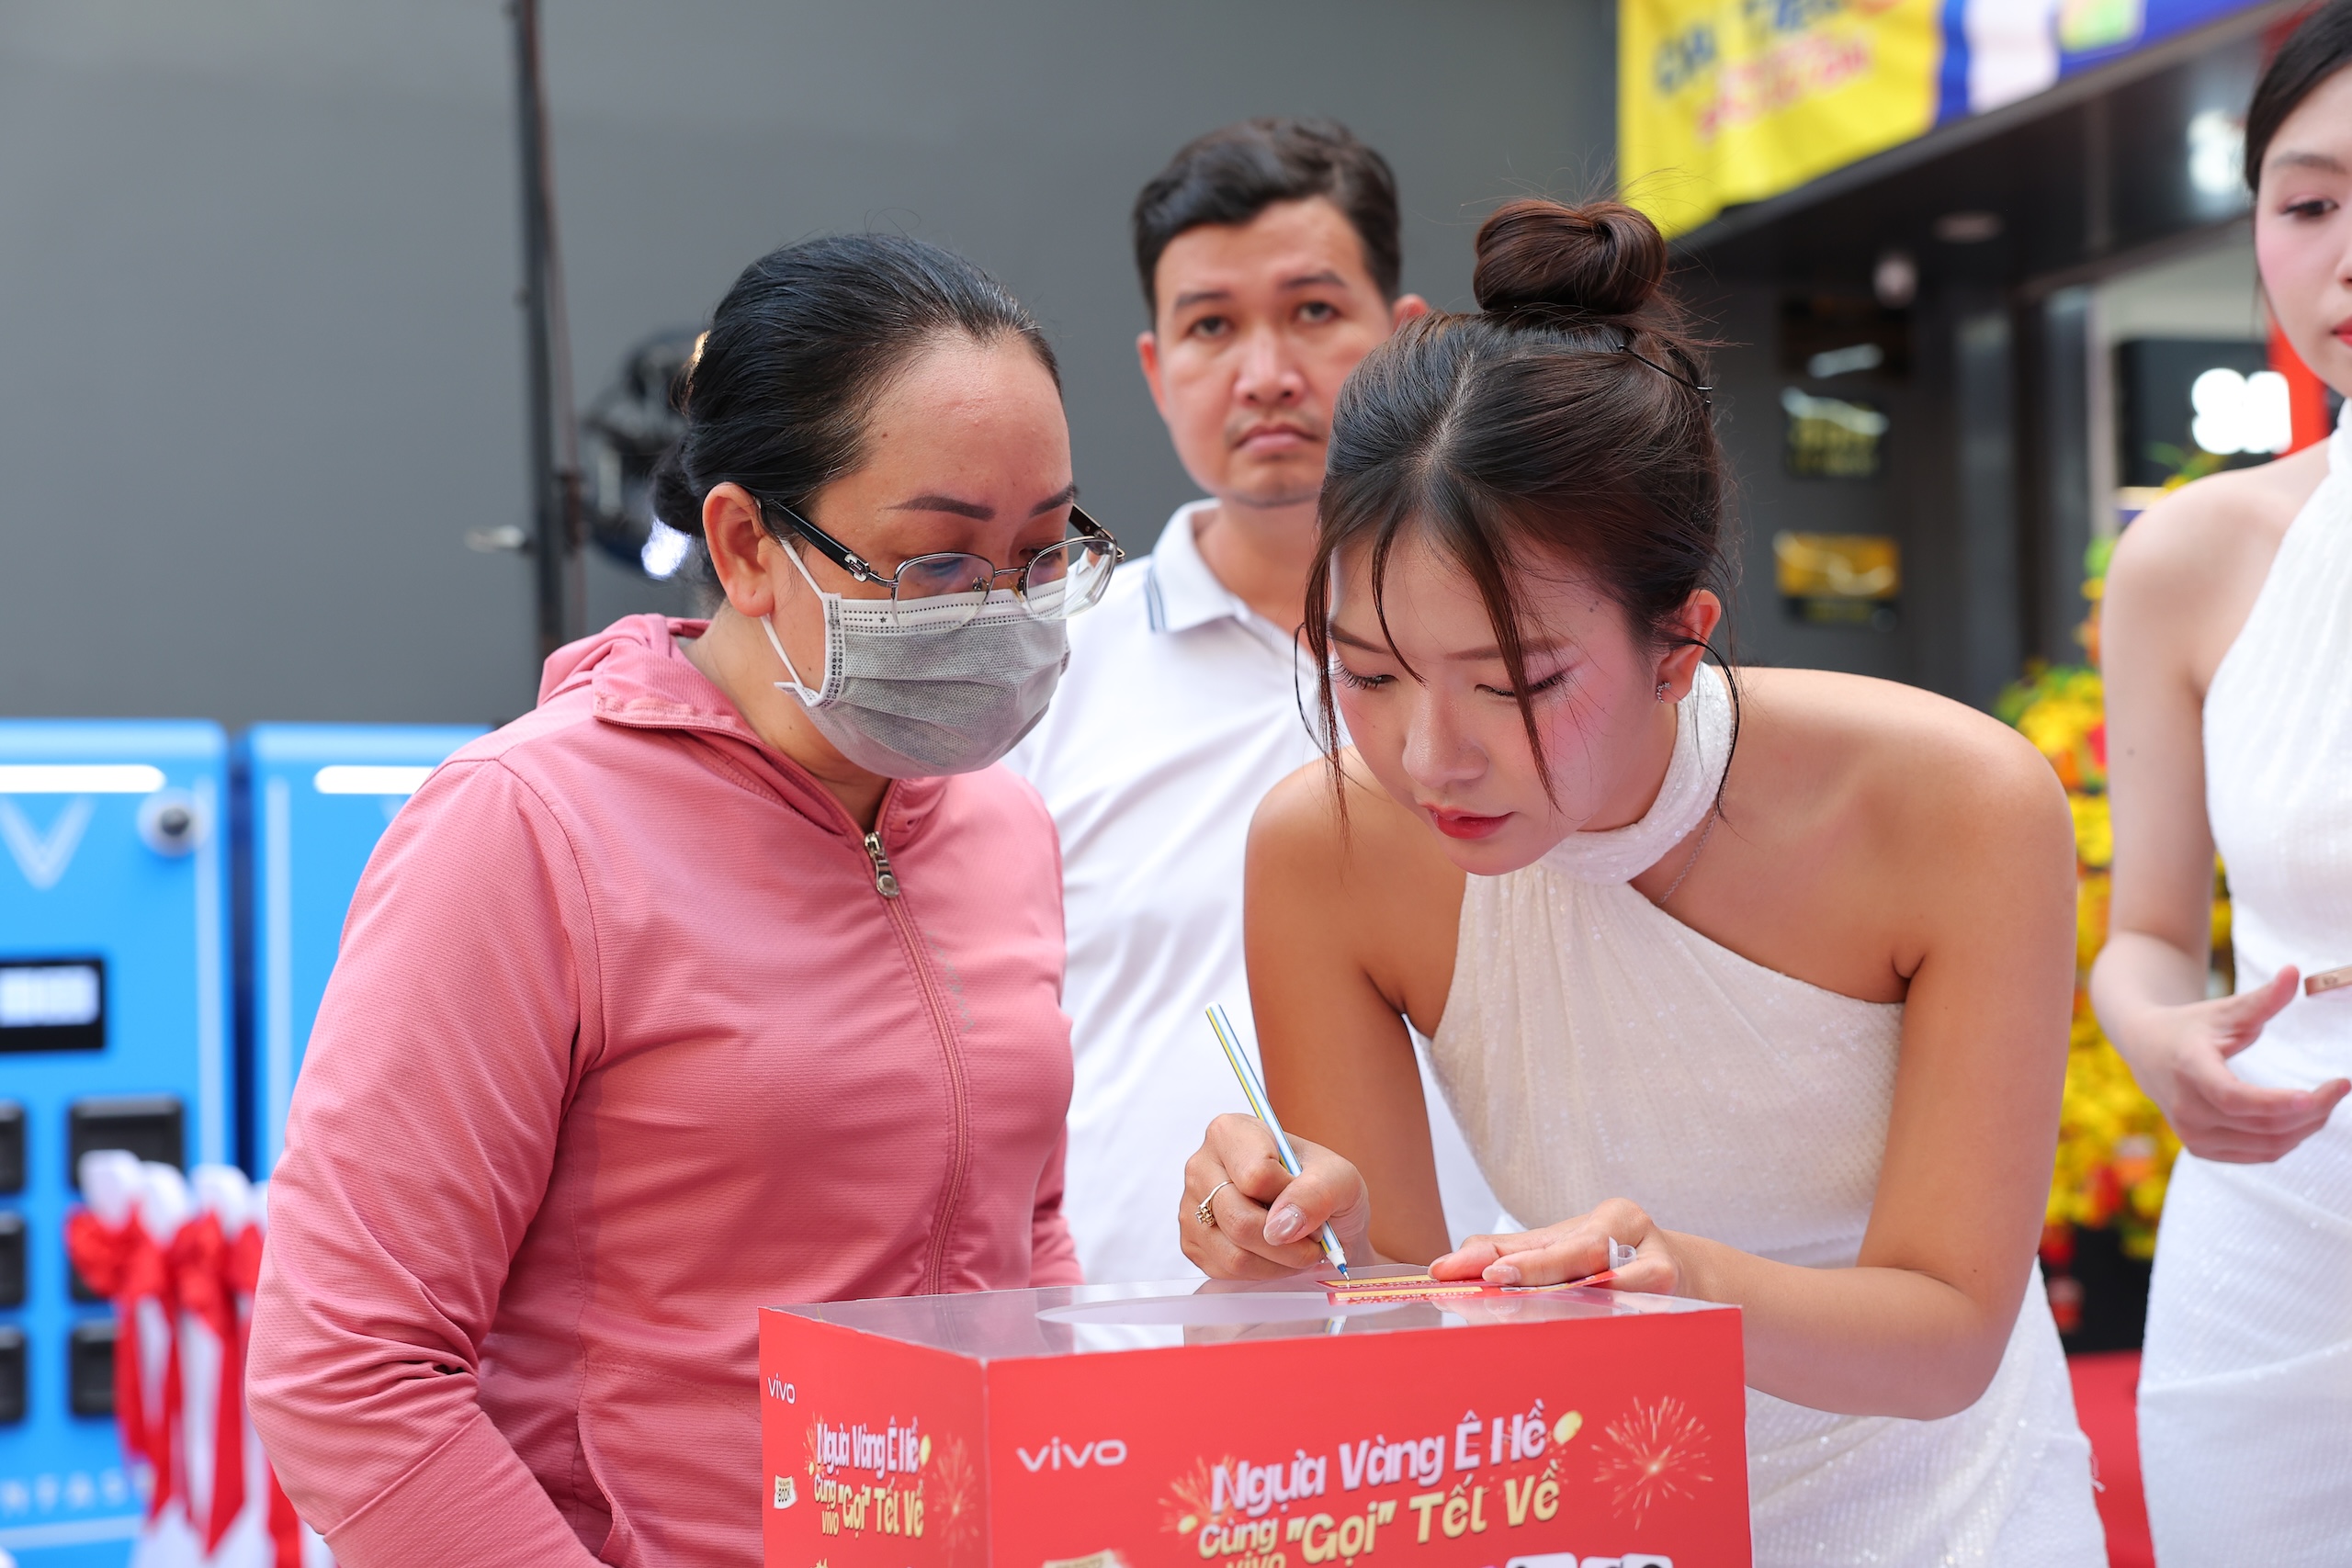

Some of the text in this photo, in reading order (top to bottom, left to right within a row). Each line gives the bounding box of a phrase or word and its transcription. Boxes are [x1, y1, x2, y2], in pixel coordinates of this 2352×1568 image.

[768, 1372, 796, 1404] vivo
[852, 1423, 886, 1480] Vàng
[1015, 1436, 1127, 1472] vivo
[1338, 1434, 1445, 1491] Vàng
[1453, 1409, 1483, 1472] Ê
[1490, 1398, 1546, 1465] Hề
[821, 1504, 840, 1536] vivo
[1198, 1517, 1279, 1559] Cùng
[1408, 1472, 1487, 1544] Tết
[1504, 1459, 1560, 1527] Về
